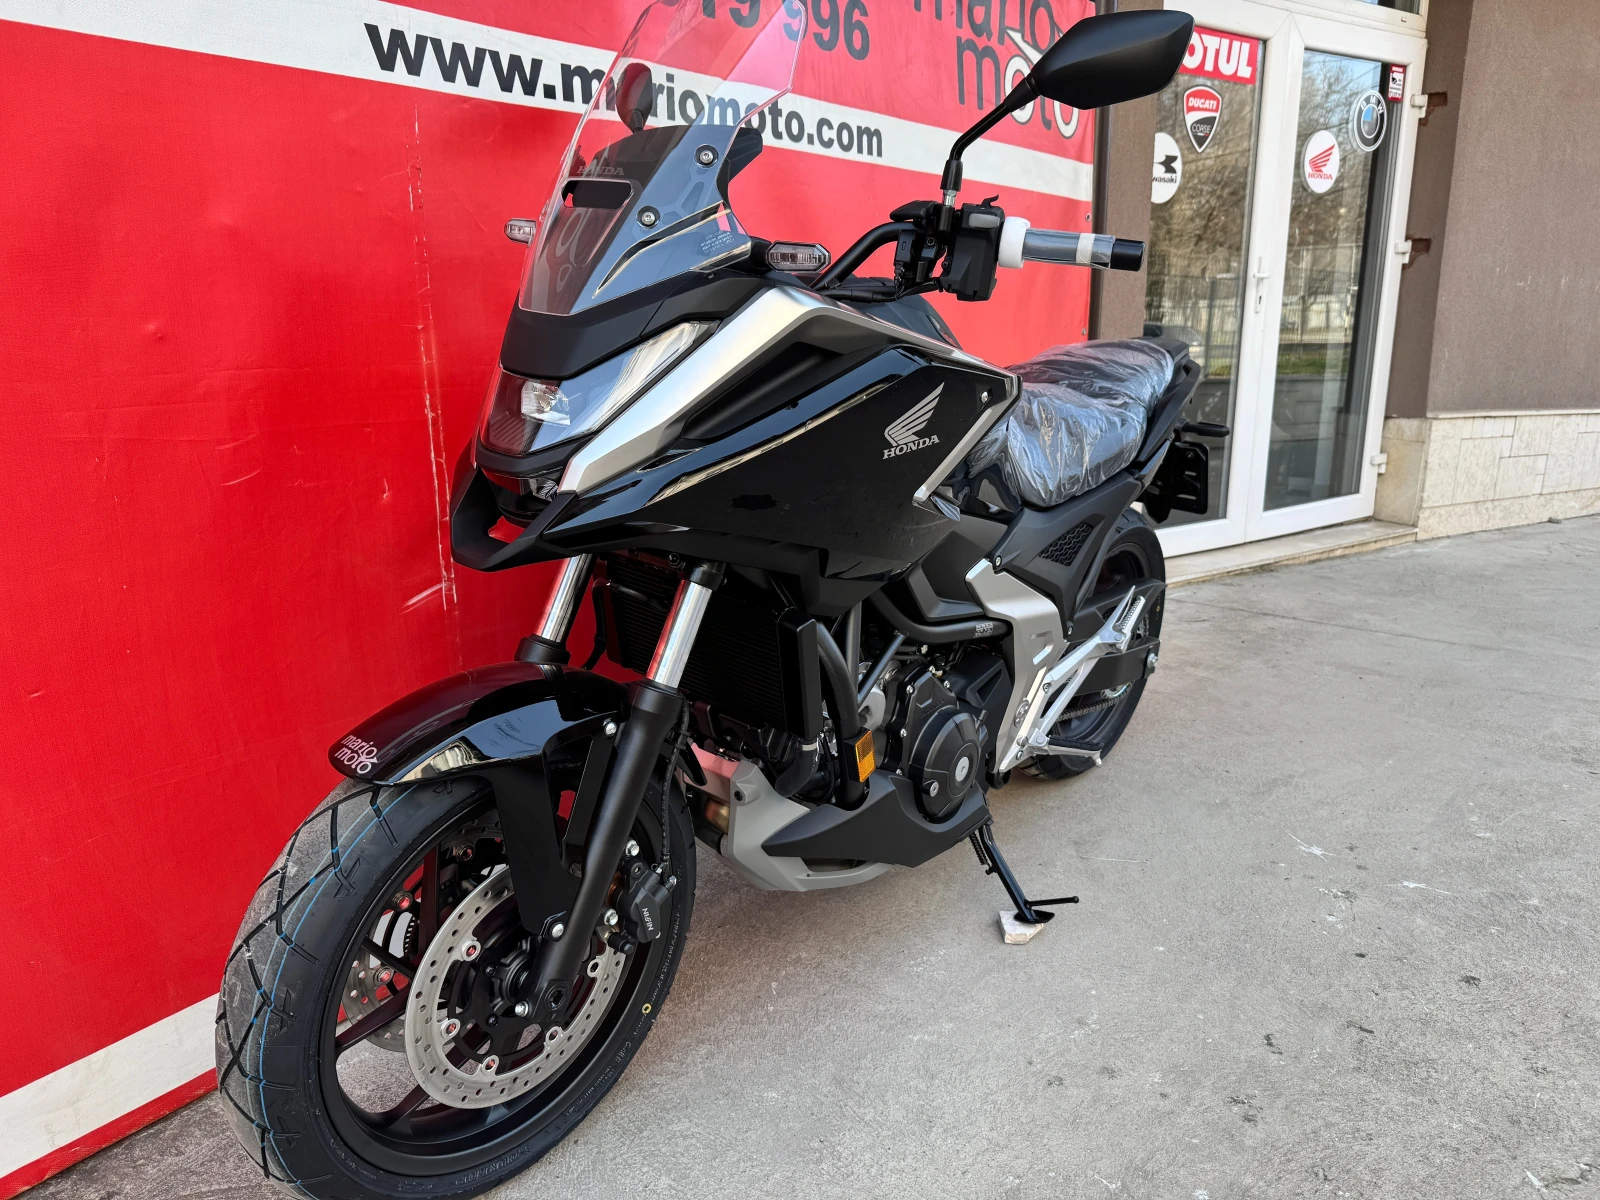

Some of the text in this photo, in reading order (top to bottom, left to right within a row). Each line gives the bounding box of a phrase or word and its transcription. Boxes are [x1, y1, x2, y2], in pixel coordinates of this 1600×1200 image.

[783, 0, 869, 61] 996
[1182, 32, 1253, 79] OTUL
[363, 22, 883, 157] www.mriomoto.com
[1188, 97, 1217, 110] DUCATI
[1192, 124, 1211, 134] CORSE
[1152, 175, 1178, 185] wasaki
[1307, 172, 1334, 181] HONDA
[882, 435, 940, 460] HONDA
[340, 734, 378, 759] mario
[333, 746, 373, 775] moto
